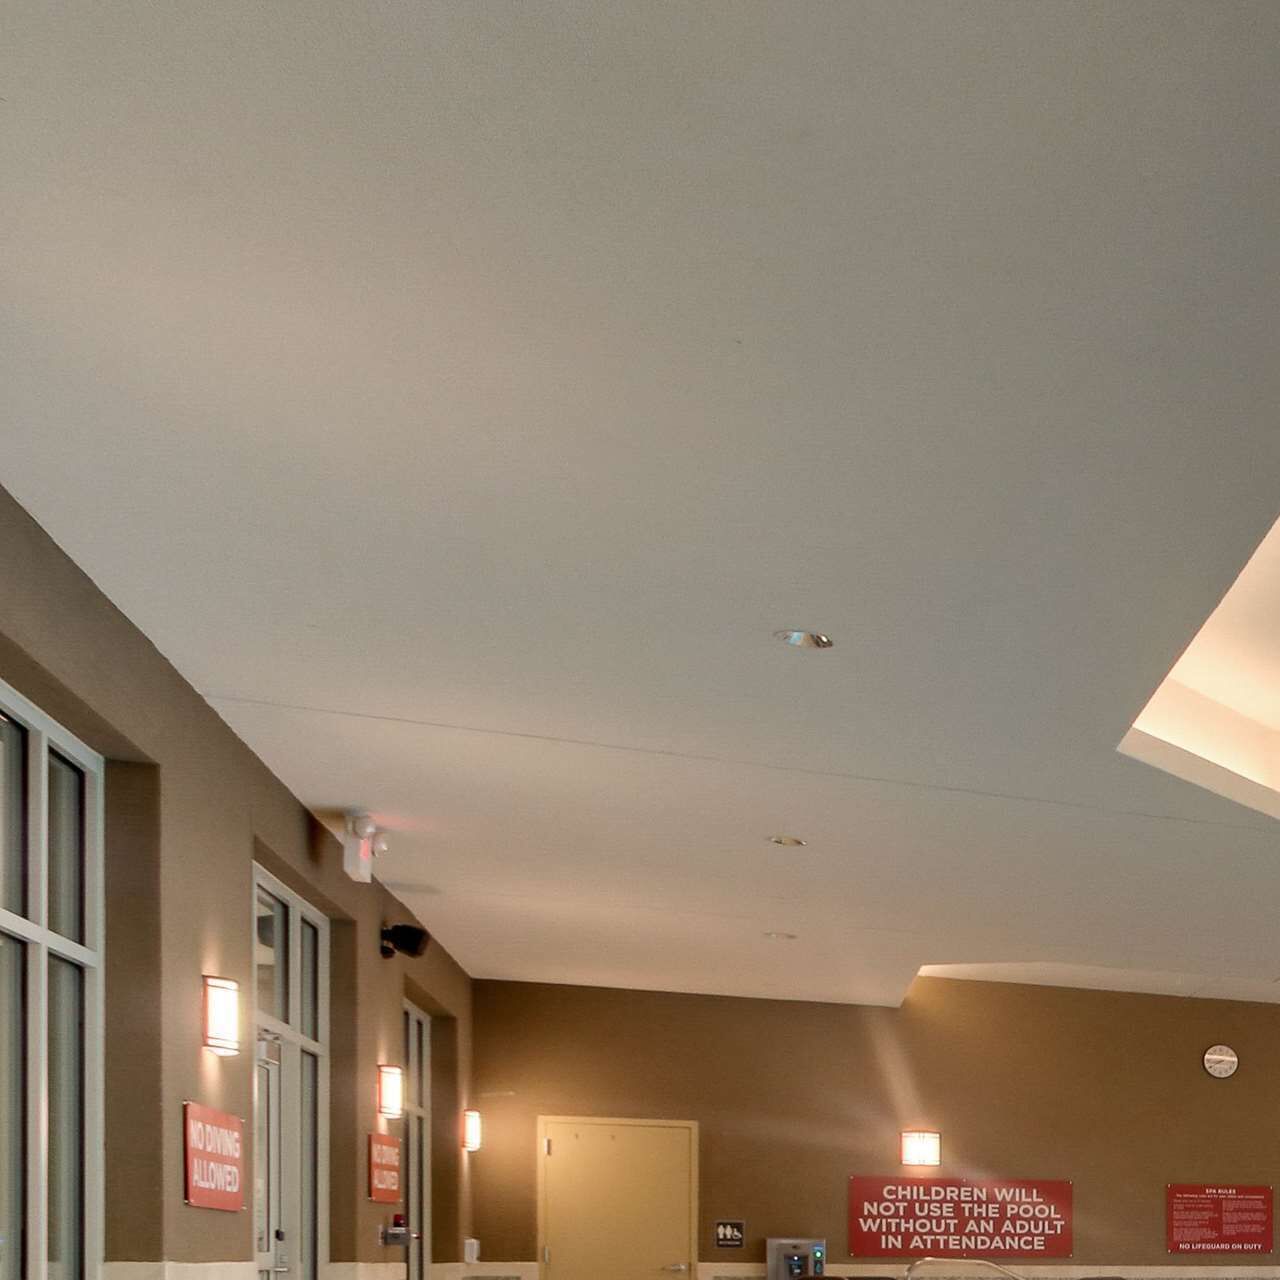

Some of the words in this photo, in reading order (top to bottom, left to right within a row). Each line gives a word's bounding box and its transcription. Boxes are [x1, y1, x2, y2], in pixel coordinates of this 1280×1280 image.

[191, 1119, 204, 1150] NO
[205, 1124, 240, 1159] DIVING
[192, 1158, 240, 1193] ALLOWED
[883, 1185, 987, 1200] CHILDREN
[994, 1188, 1044, 1201] WILL
[863, 1201, 908, 1216] NOT
[915, 1202, 954, 1217] USE
[961, 1203, 1000, 1217] THE
[1006, 1204, 1061, 1218] POOL
[859, 1218, 958, 1233] WITHOUT
[964, 1219, 994, 1233] AN
[1001, 1220, 1065, 1235] ADULT
[881, 1235, 902, 1249] IN
[909, 1235, 1045, 1250] ATTENDANCE
